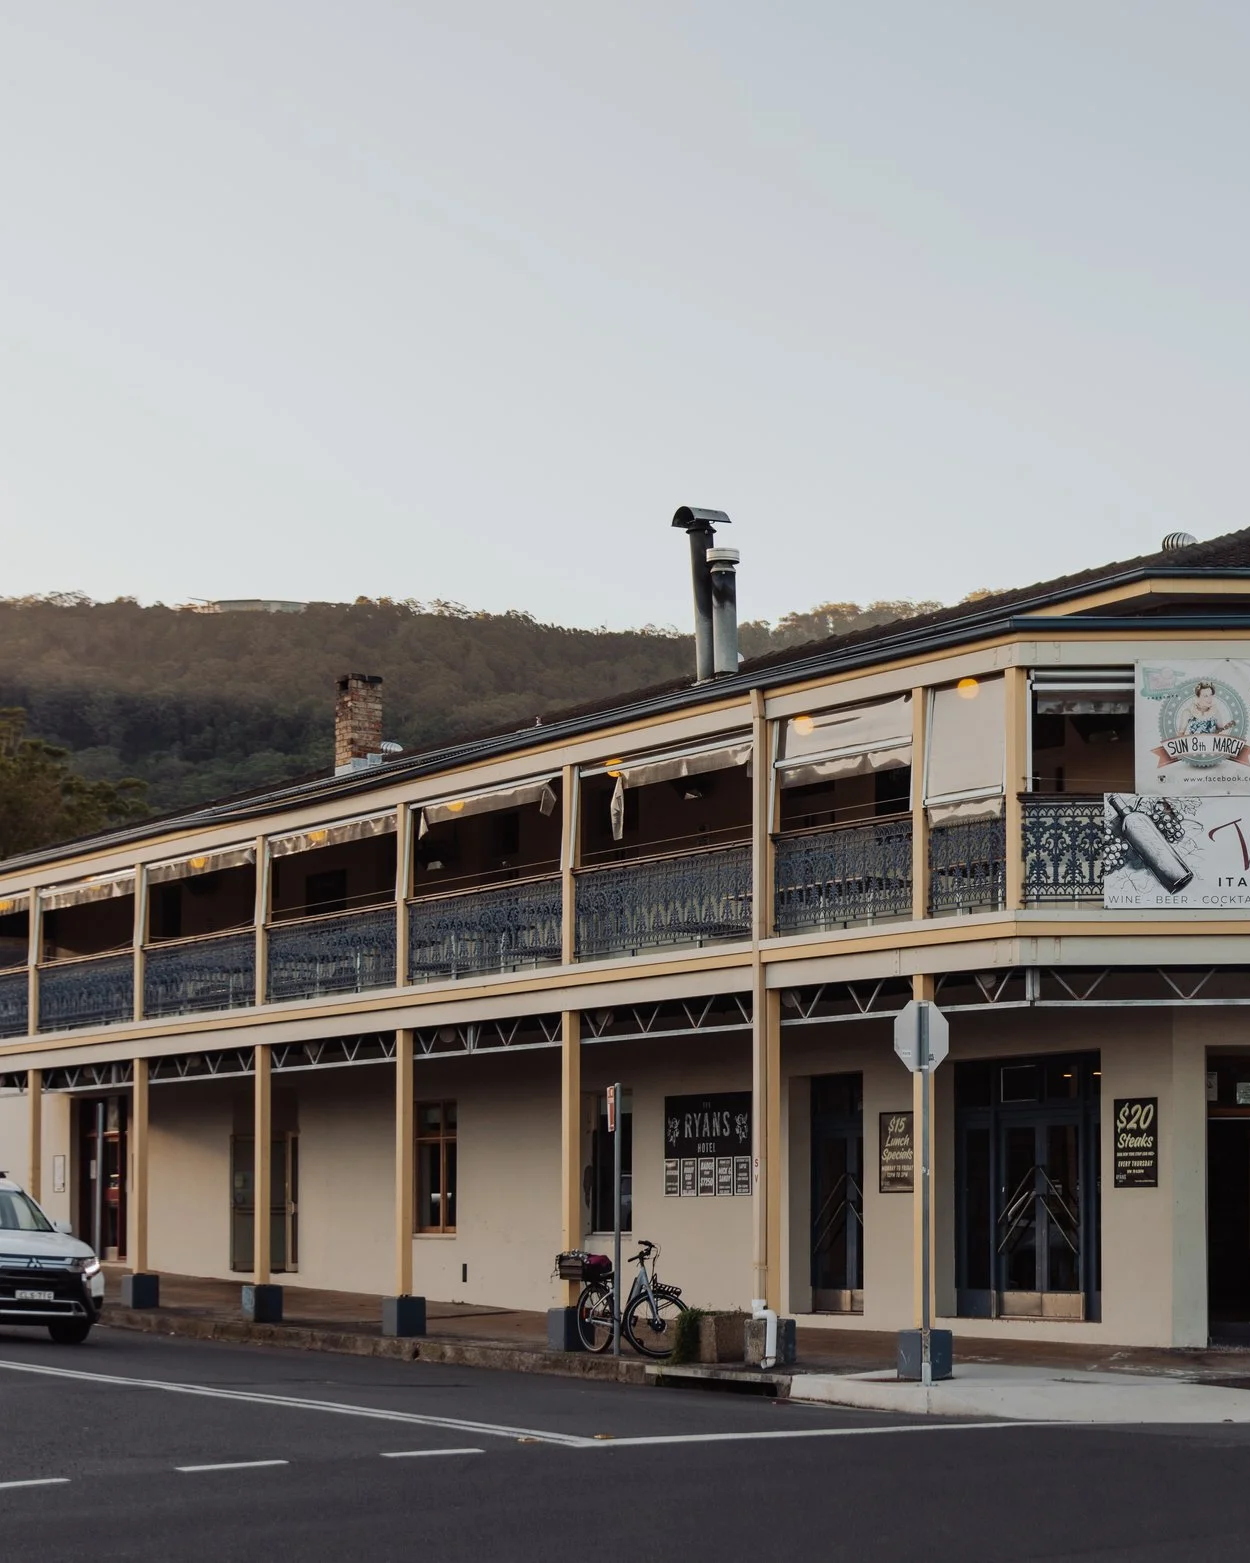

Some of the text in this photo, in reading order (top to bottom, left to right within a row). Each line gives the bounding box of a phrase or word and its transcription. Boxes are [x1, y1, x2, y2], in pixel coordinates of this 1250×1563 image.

[1168, 737, 1244, 757] SUN 8th MARCH
[1108, 896, 1141, 904] WINE
[1156, 896, 1188, 904] BEER
[684, 1111, 730, 1138] RYANS
[888, 1116, 906, 1133] $15
[1117, 1102, 1154, 1133] $20
[698, 1142, 716, 1153] HOTEL
[885, 1135, 909, 1147] Lunch
[1118, 1133, 1153, 1148] Steaks
[882, 1148, 913, 1163] Specials
